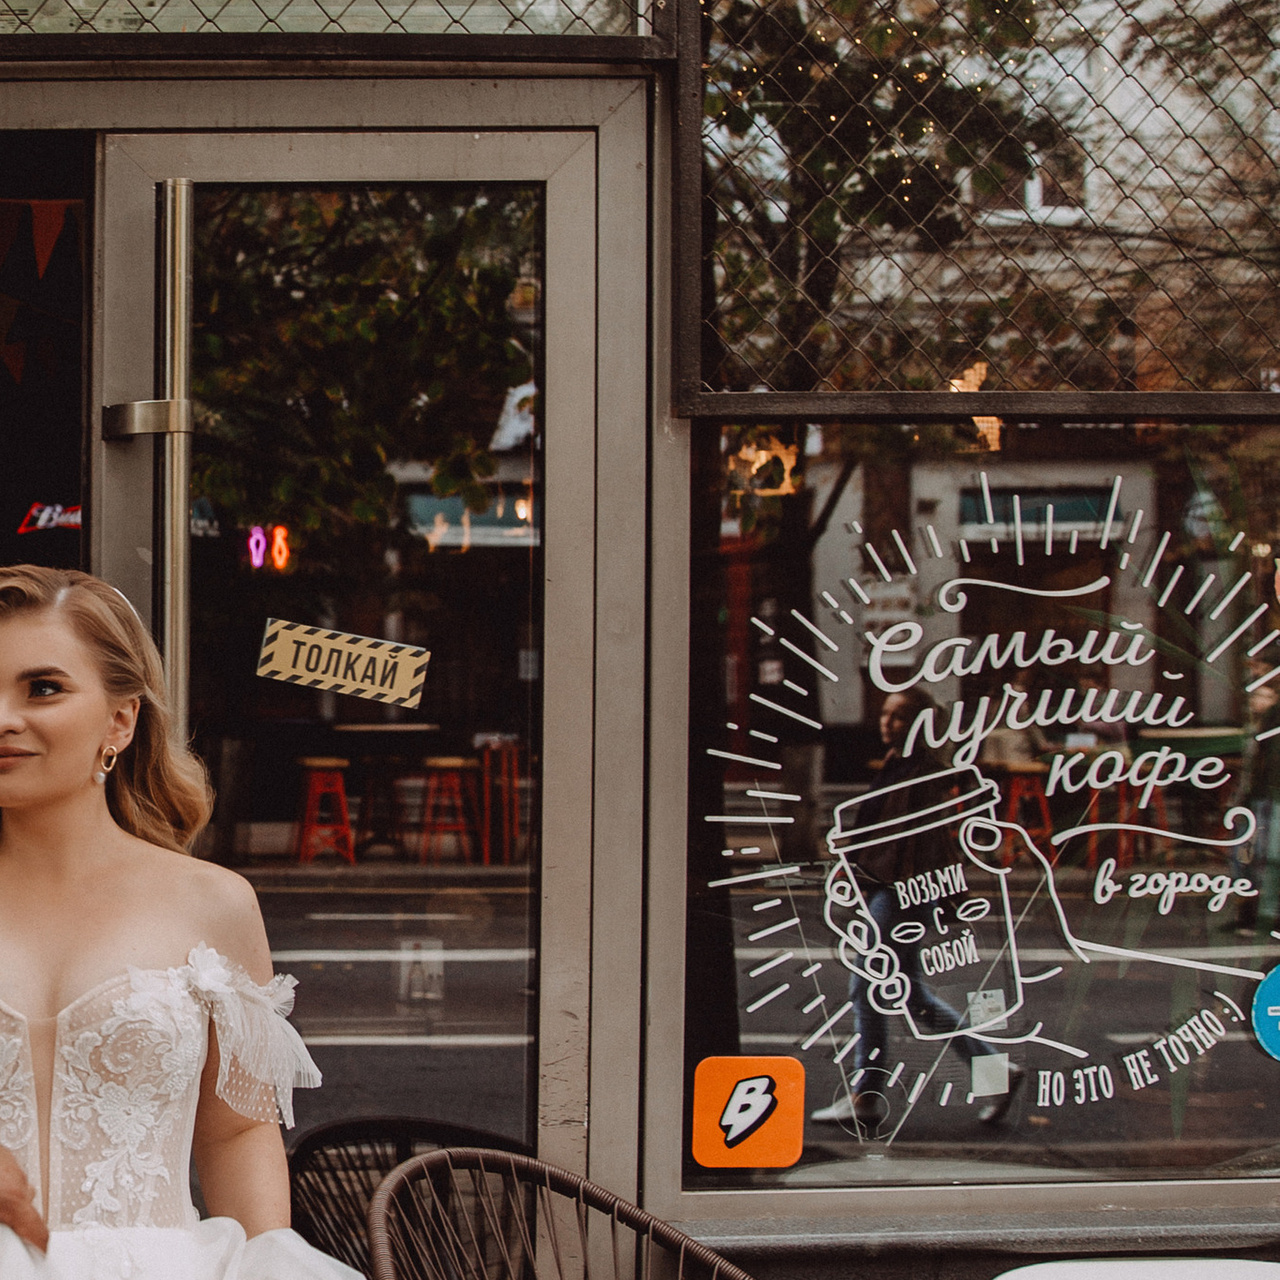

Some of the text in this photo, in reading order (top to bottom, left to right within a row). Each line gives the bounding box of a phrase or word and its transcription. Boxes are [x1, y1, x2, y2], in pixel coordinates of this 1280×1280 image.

[291, 639, 400, 690] ТОЛКАЙ
[866, 622, 1156, 692] Самый
[901, 671, 1195, 764] лучший
[1044, 746, 1232, 809] кофе
[894, 863, 969, 910] ВОЗЬМИ
[1094, 858, 1259, 915] в городе
[932, 907, 949, 935] С
[920, 928, 980, 976] СОБОЙ
[1037, 1070, 1065, 1107] НО
[1072, 1064, 1114, 1105] ЭТО
[1122, 1049, 1160, 1091] НЕ
[1153, 1009, 1226, 1073] ТОЧНО
